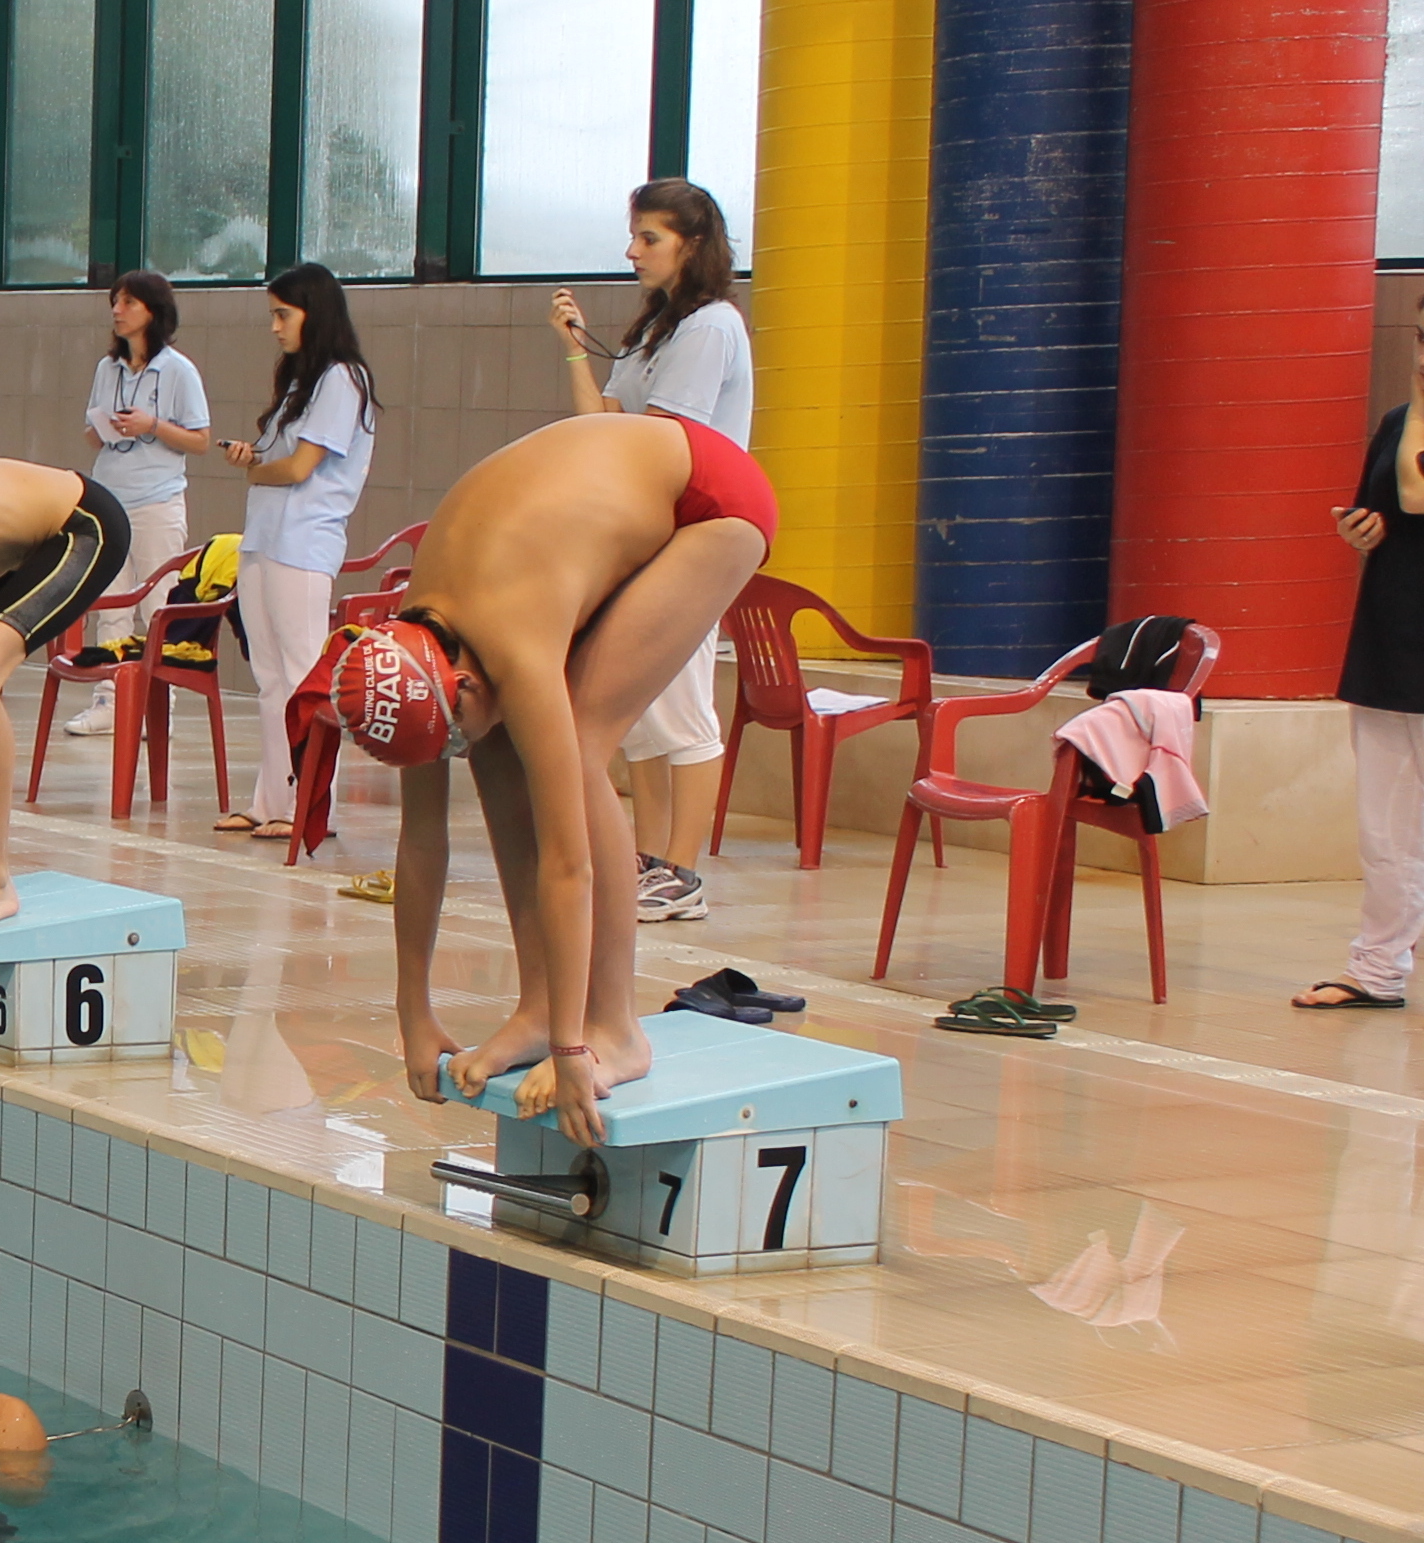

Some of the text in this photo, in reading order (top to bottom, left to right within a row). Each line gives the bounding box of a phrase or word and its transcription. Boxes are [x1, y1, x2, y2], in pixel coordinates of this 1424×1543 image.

[368, 630, 402, 744] BRAGA
[66, 964, 104, 1046] 6
[658, 1170, 682, 1236] 7
[758, 1145, 807, 1250] 7
